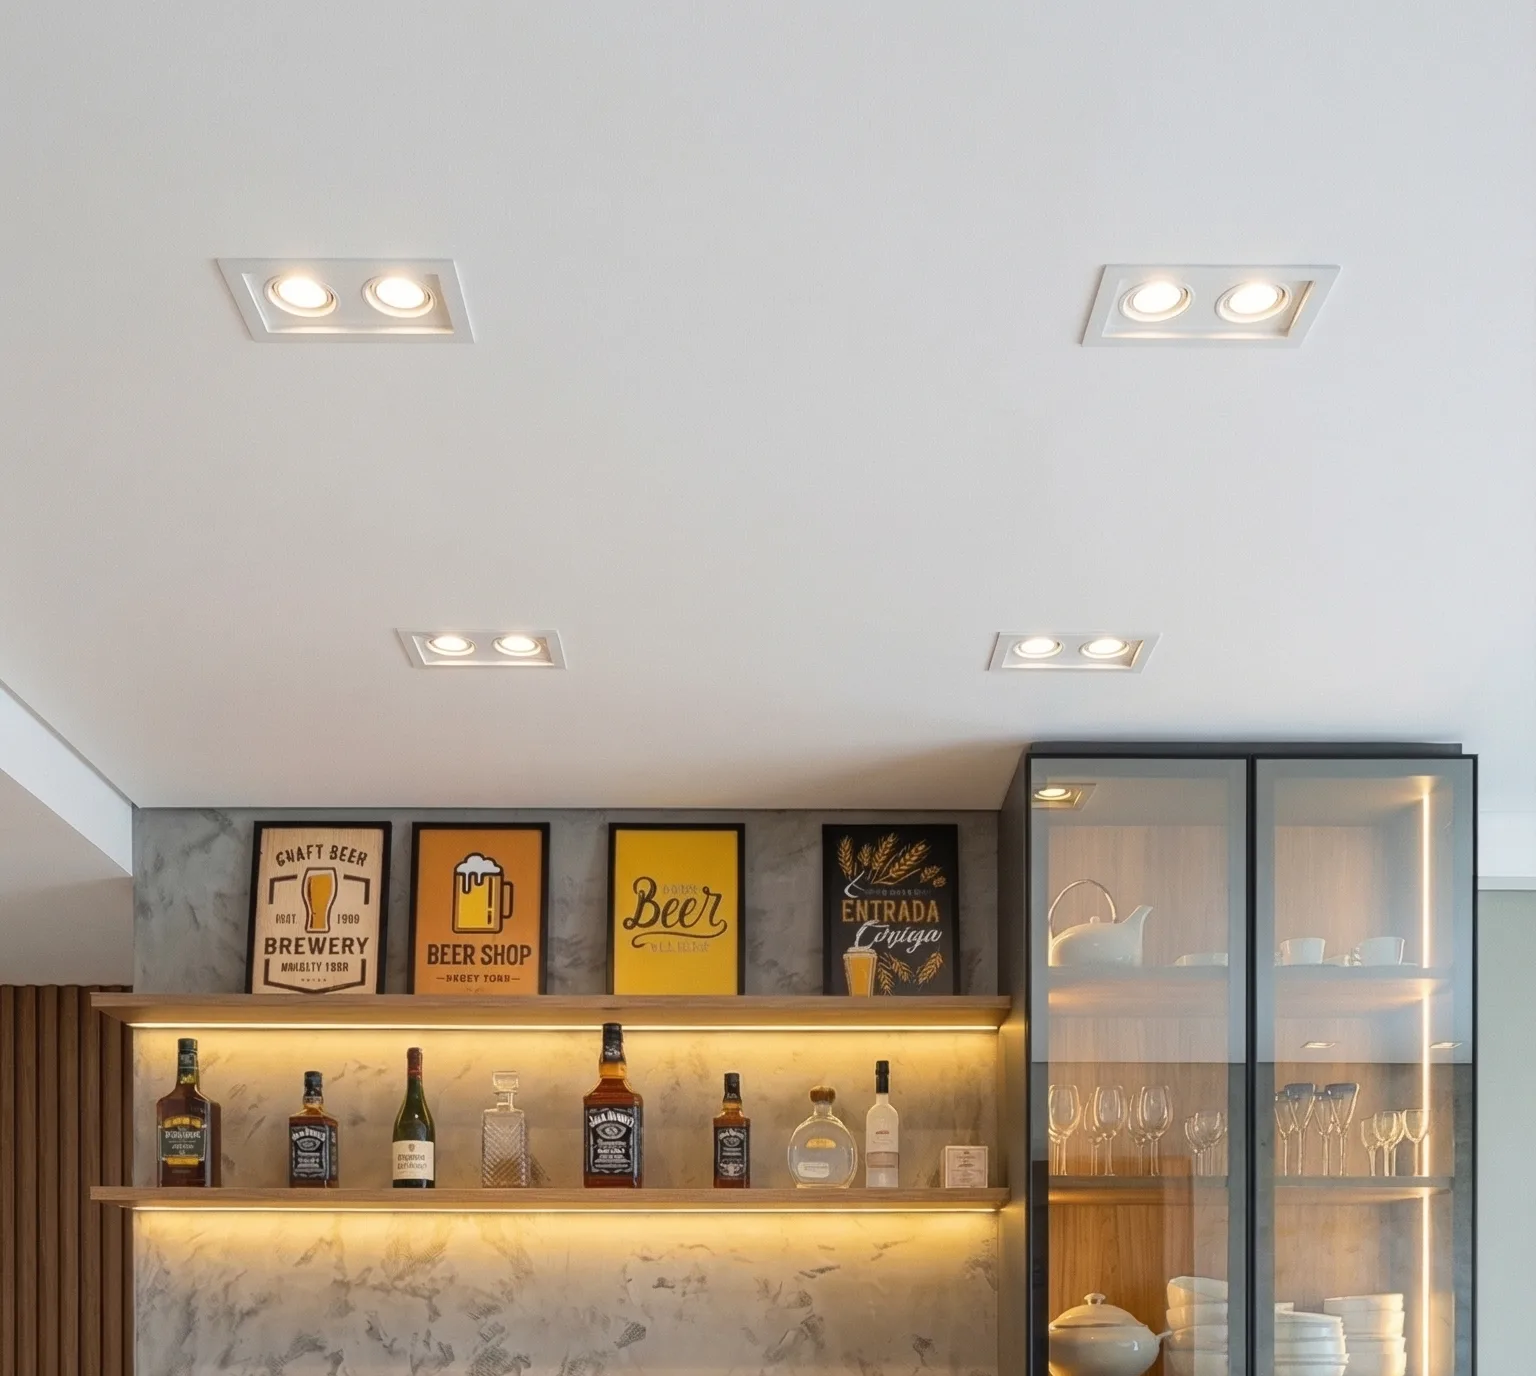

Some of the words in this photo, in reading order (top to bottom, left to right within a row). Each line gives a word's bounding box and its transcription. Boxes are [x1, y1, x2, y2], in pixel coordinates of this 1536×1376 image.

[329, 844, 369, 867] BEER
[623, 876, 728, 940] Beer
[842, 899, 940, 922] ENTRADA
[264, 936, 370, 955] BREWERY
[426, 943, 476, 966] BEER
[480, 943, 532, 966] SHOP
